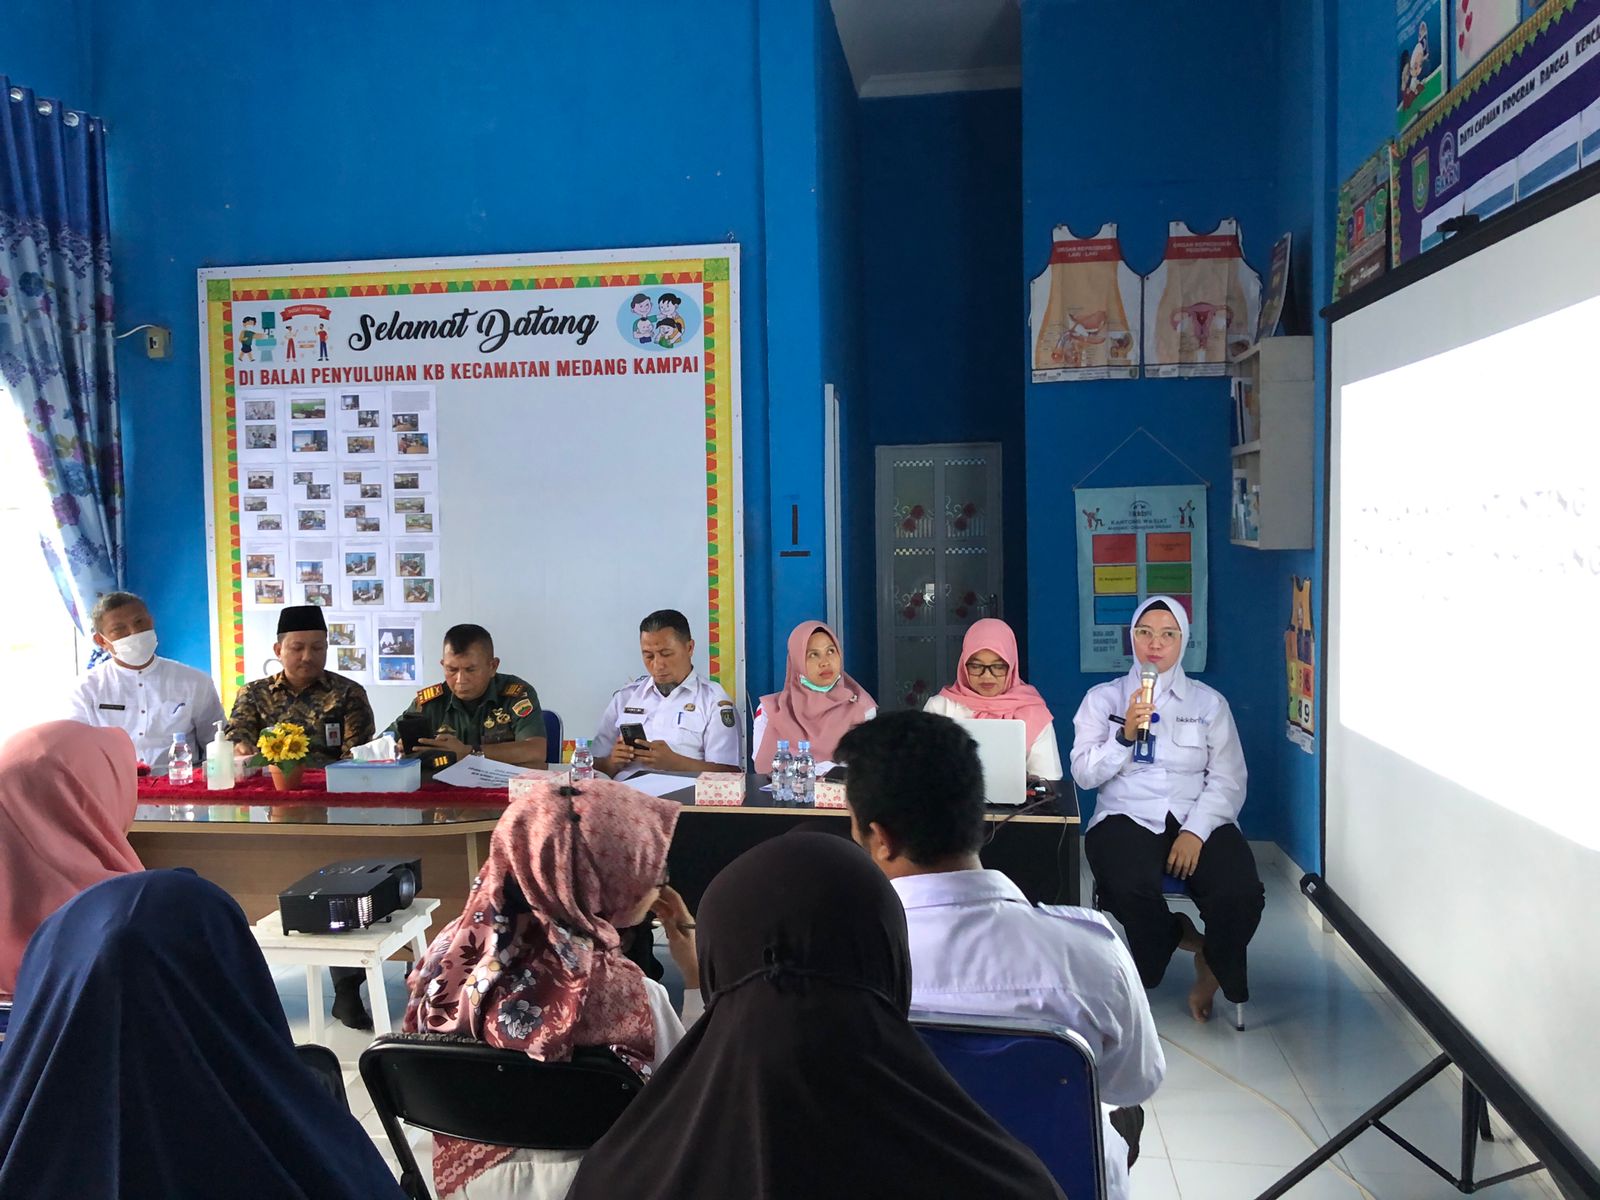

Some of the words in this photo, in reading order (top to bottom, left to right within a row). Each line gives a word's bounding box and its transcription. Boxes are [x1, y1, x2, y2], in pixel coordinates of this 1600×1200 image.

[1460, 124, 1474, 146] DATA
[1475, 104, 1501, 134] CAPAIAN
[1502, 77, 1536, 114] PROGRAM
[348, 308, 478, 351] Selamat
[477, 305, 599, 353] Datang
[239, 370, 254, 386] DI
[260, 368, 305, 385] BALAI
[311, 365, 416, 384] PENYULUHAN
[423, 364, 445, 381] KB
[451, 361, 550, 379] KECAMATAN
[556, 359, 627, 377] MEDANG
[633, 356, 699, 374] KAMPAI
